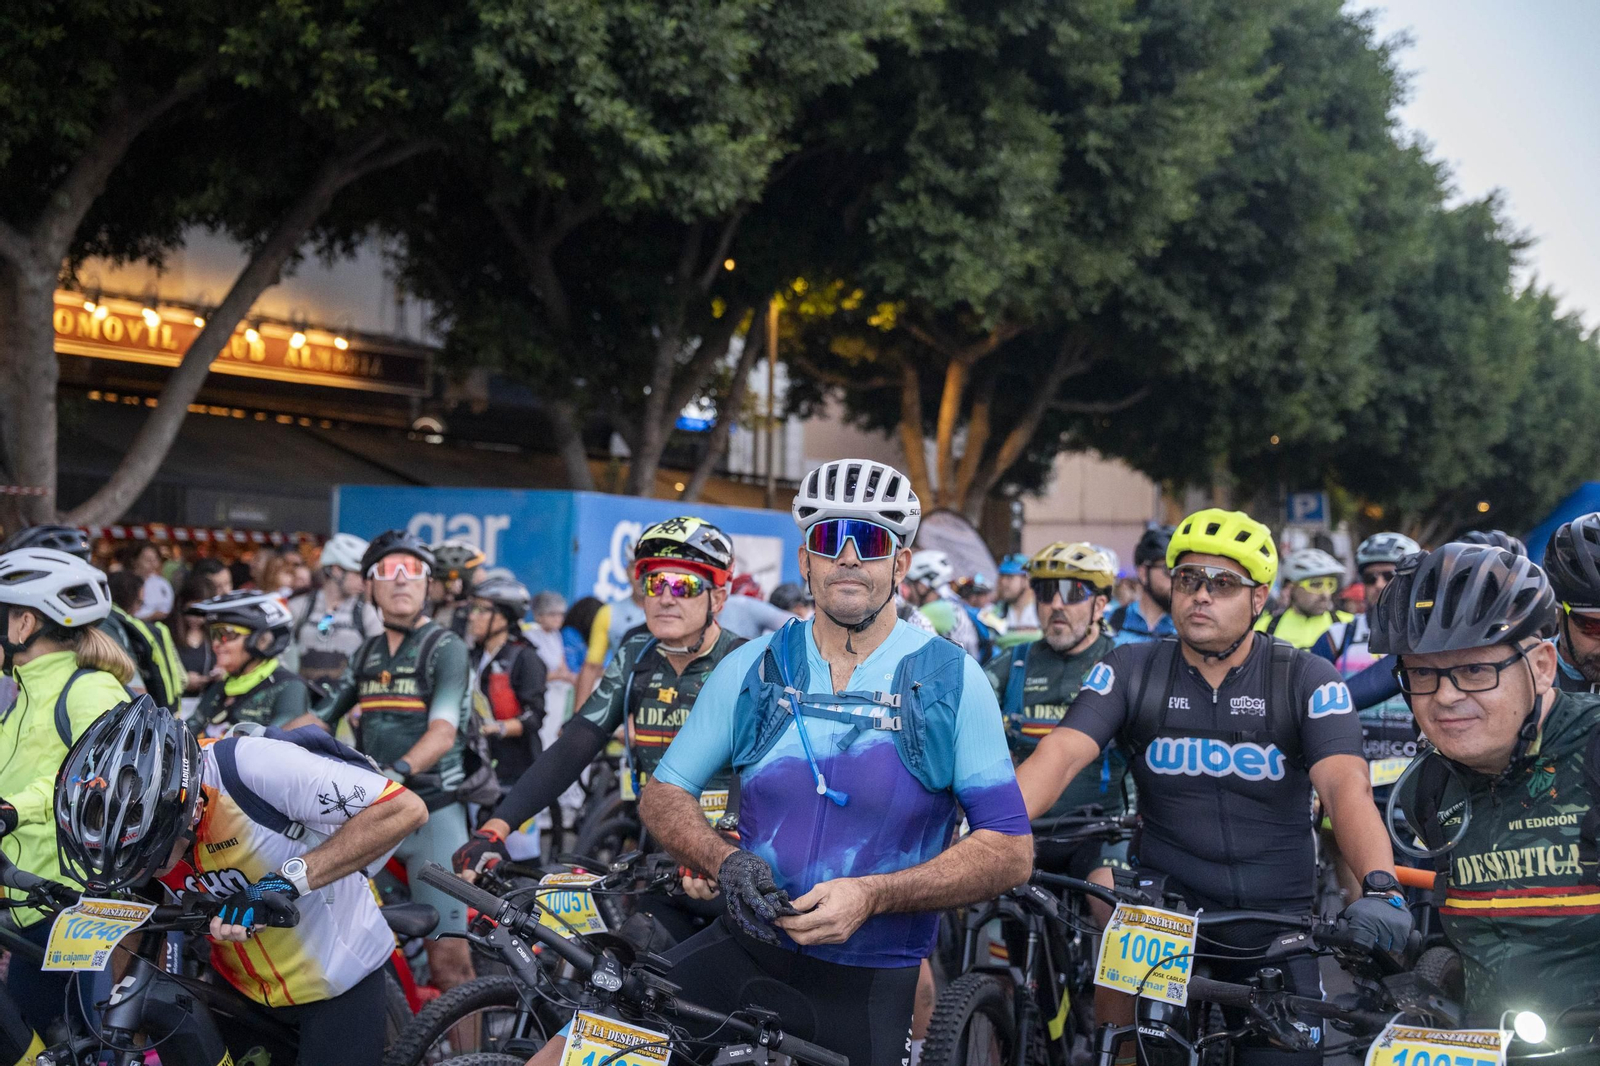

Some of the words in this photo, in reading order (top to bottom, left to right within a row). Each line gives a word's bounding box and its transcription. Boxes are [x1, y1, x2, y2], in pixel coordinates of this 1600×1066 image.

[1293, 494, 1317, 519] P
[1229, 695, 1266, 709] wiber
[1146, 736, 1287, 781] wiber
[181, 758, 190, 789] BADILLO
[1508, 820, 1523, 831] VII
[1525, 812, 1578, 829] EDICIÓN
[1457, 843, 1584, 886] DESÉRTICA
[64, 917, 132, 942] 10248
[62, 951, 92, 964] cajamar
[1119, 931, 1190, 974] 10054
[1152, 971, 1165, 979] JOSE
[1166, 974, 1187, 984] CARLOS
[592, 1024, 604, 1038] LA
[1138, 1026, 1166, 1038] GALFER
